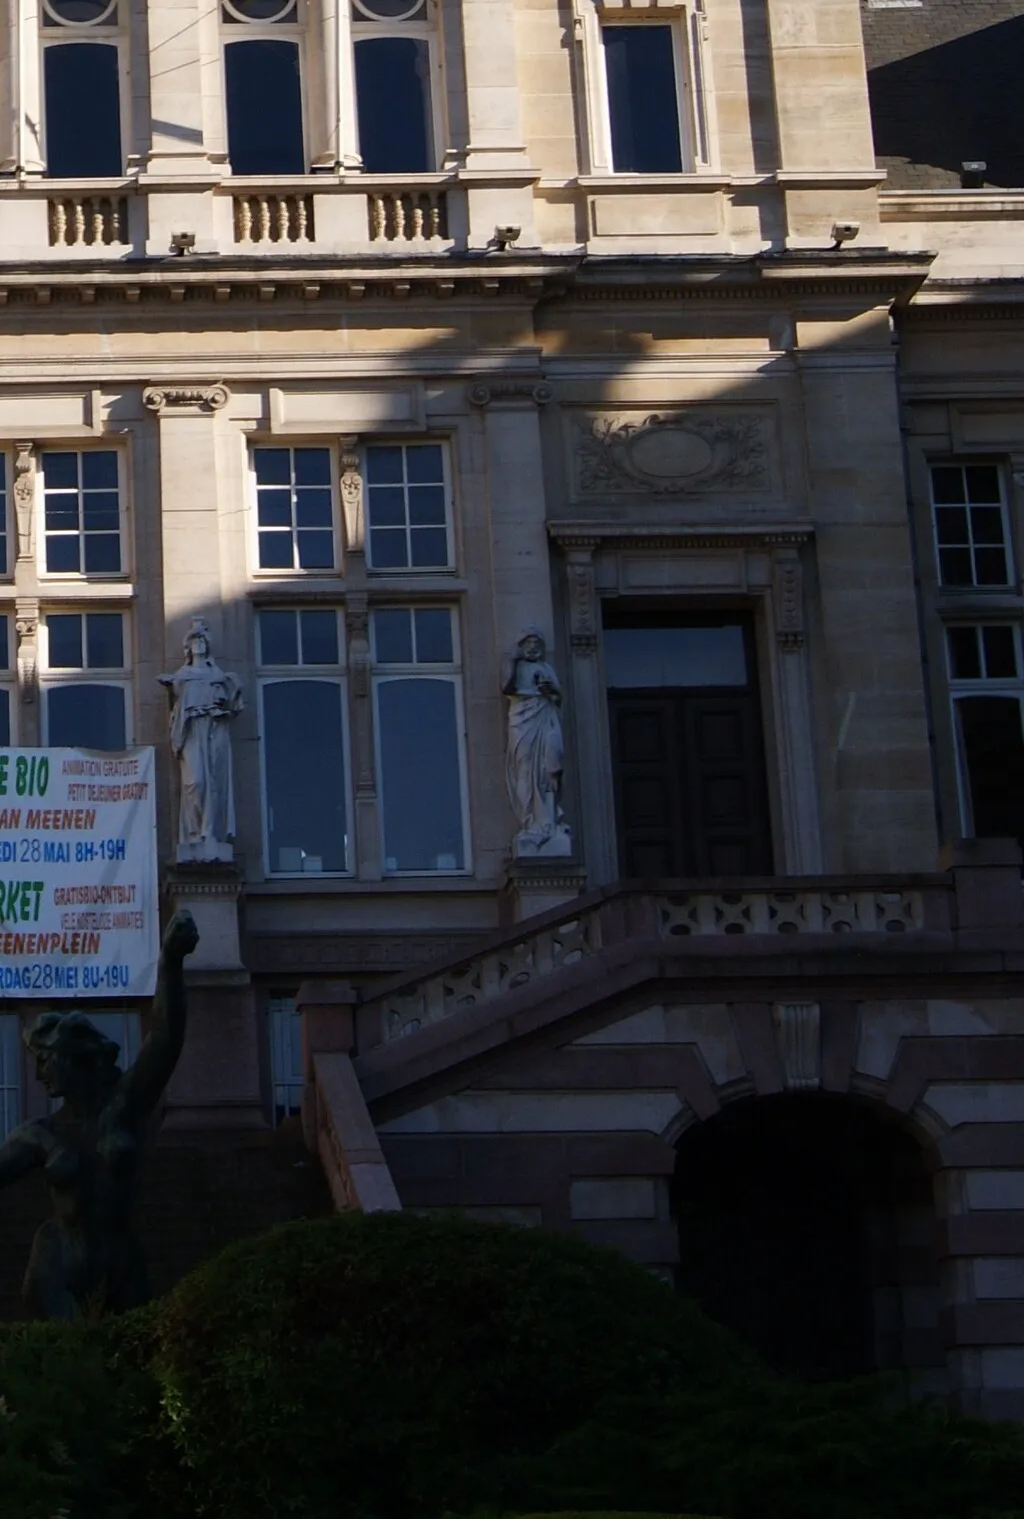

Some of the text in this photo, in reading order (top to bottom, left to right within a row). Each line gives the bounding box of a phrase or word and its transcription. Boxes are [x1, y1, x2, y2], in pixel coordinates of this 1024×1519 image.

[16, 755, 49, 797] BIO
[62, 760, 139, 777] ANIMATION GRATUITE
[68, 782, 149, 802] PETIT DEJEUNER GRATUIT
[25, 809, 96, 830] MEENEN
[20, 838, 41, 862] 28
[44, 839, 70, 863] MAI
[75, 839, 125, 862] 8H-19H
[32, 964, 53, 989] 28
[55, 966, 79, 989] MEI
[83, 965, 129, 988] 8U-19U
